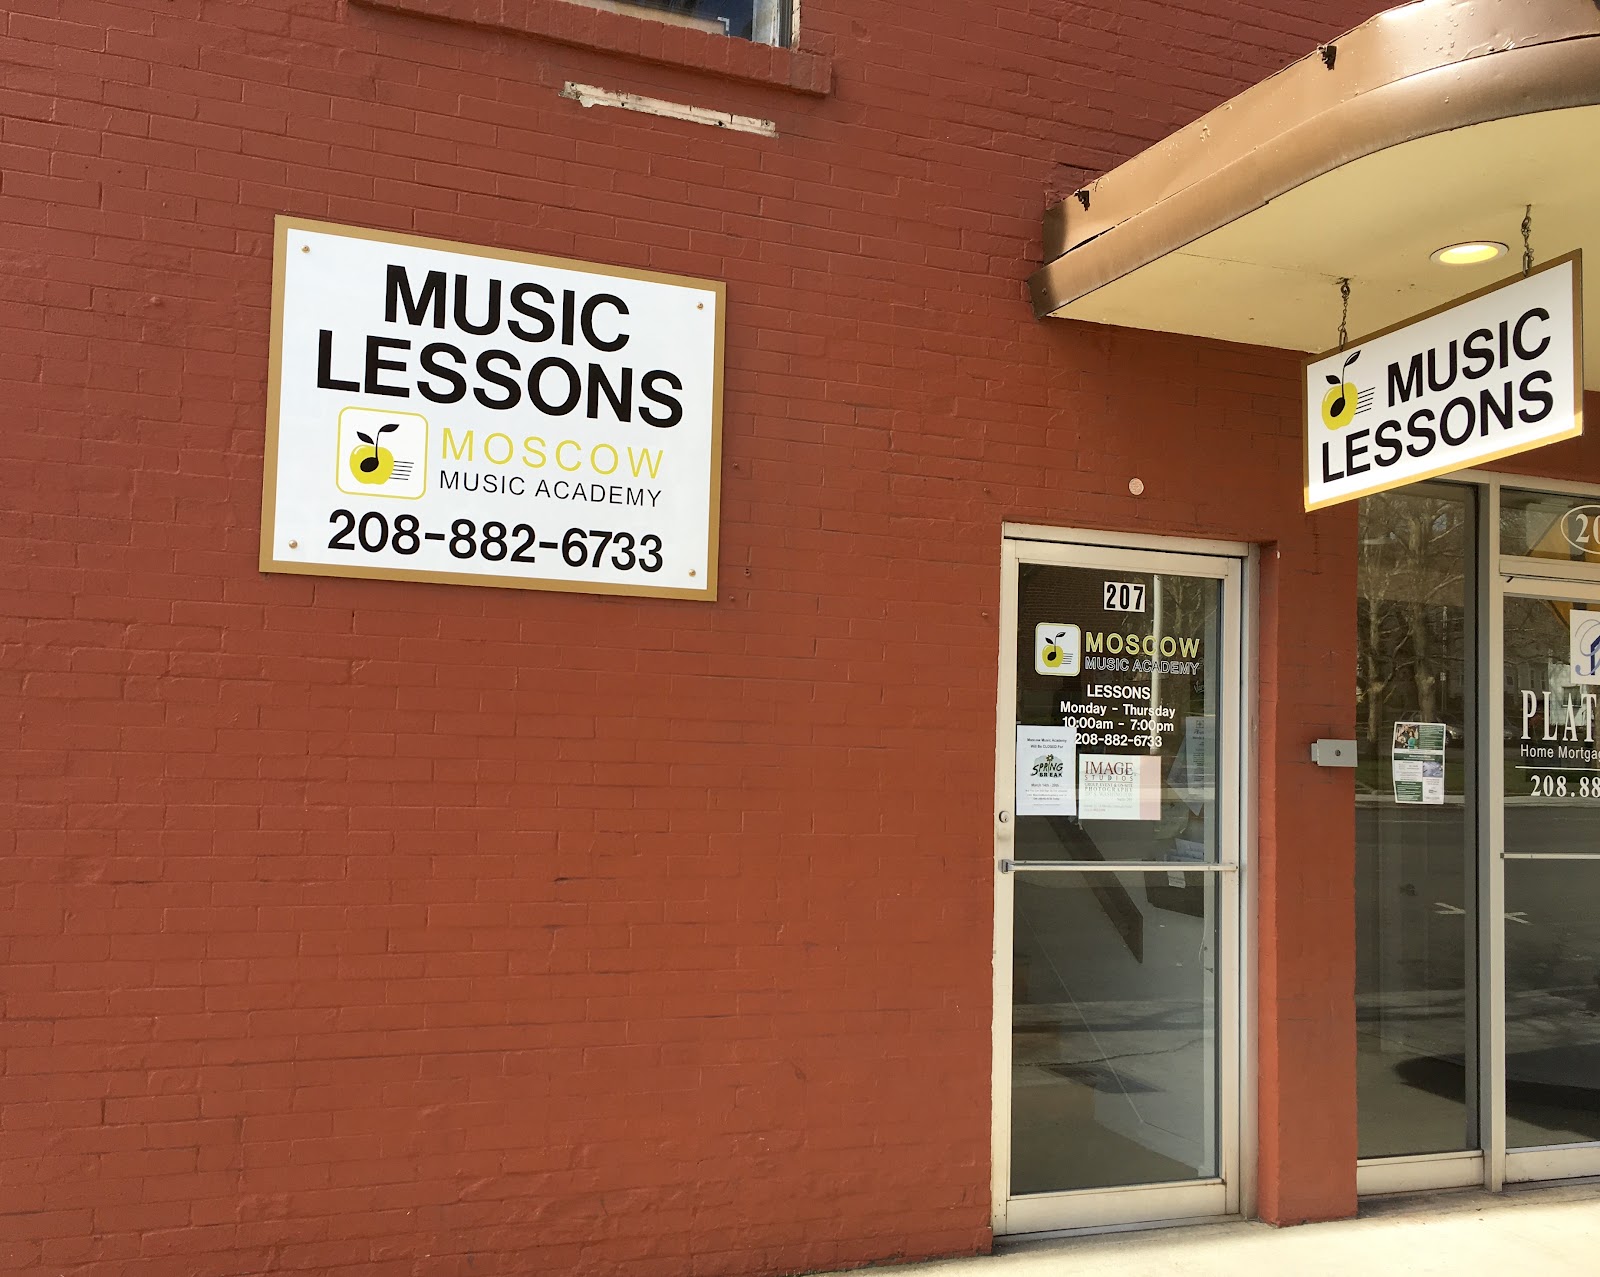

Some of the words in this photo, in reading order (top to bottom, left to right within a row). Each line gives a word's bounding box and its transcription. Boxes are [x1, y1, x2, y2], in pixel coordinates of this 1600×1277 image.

[384, 264, 630, 352] MUSIC
[1388, 307, 1551, 408] MUSIC
[316, 329, 684, 428] LESSONS
[1322, 370, 1554, 483] LESSONS
[441, 427, 664, 480] MOSCOW
[439, 470, 527, 497] MUSIC
[535, 479, 663, 508] ACADEMY
[328, 509, 664, 573] 208-882-6733
[1106, 583, 1144, 610] 207
[1085, 632, 1200, 658] MOSCOW
[1085, 656, 1129, 672] MUSIC
[1132, 660, 1200, 675] ACADEMY
[1087, 684, 1151, 700] LESSONS
[1060, 701, 1107, 716] Monday
[1123, 704, 1176, 719] Thursday
[1062, 716, 1114, 730] 10:00am
[1130, 719, 1174, 733] 7:00pm
[1075, 732, 1163, 748] 208-882-6733
[1521, 744, 1554, 758] Home
[1030, 762, 1064, 777] SPRING
[1085, 761, 1134, 775] IMAGE
